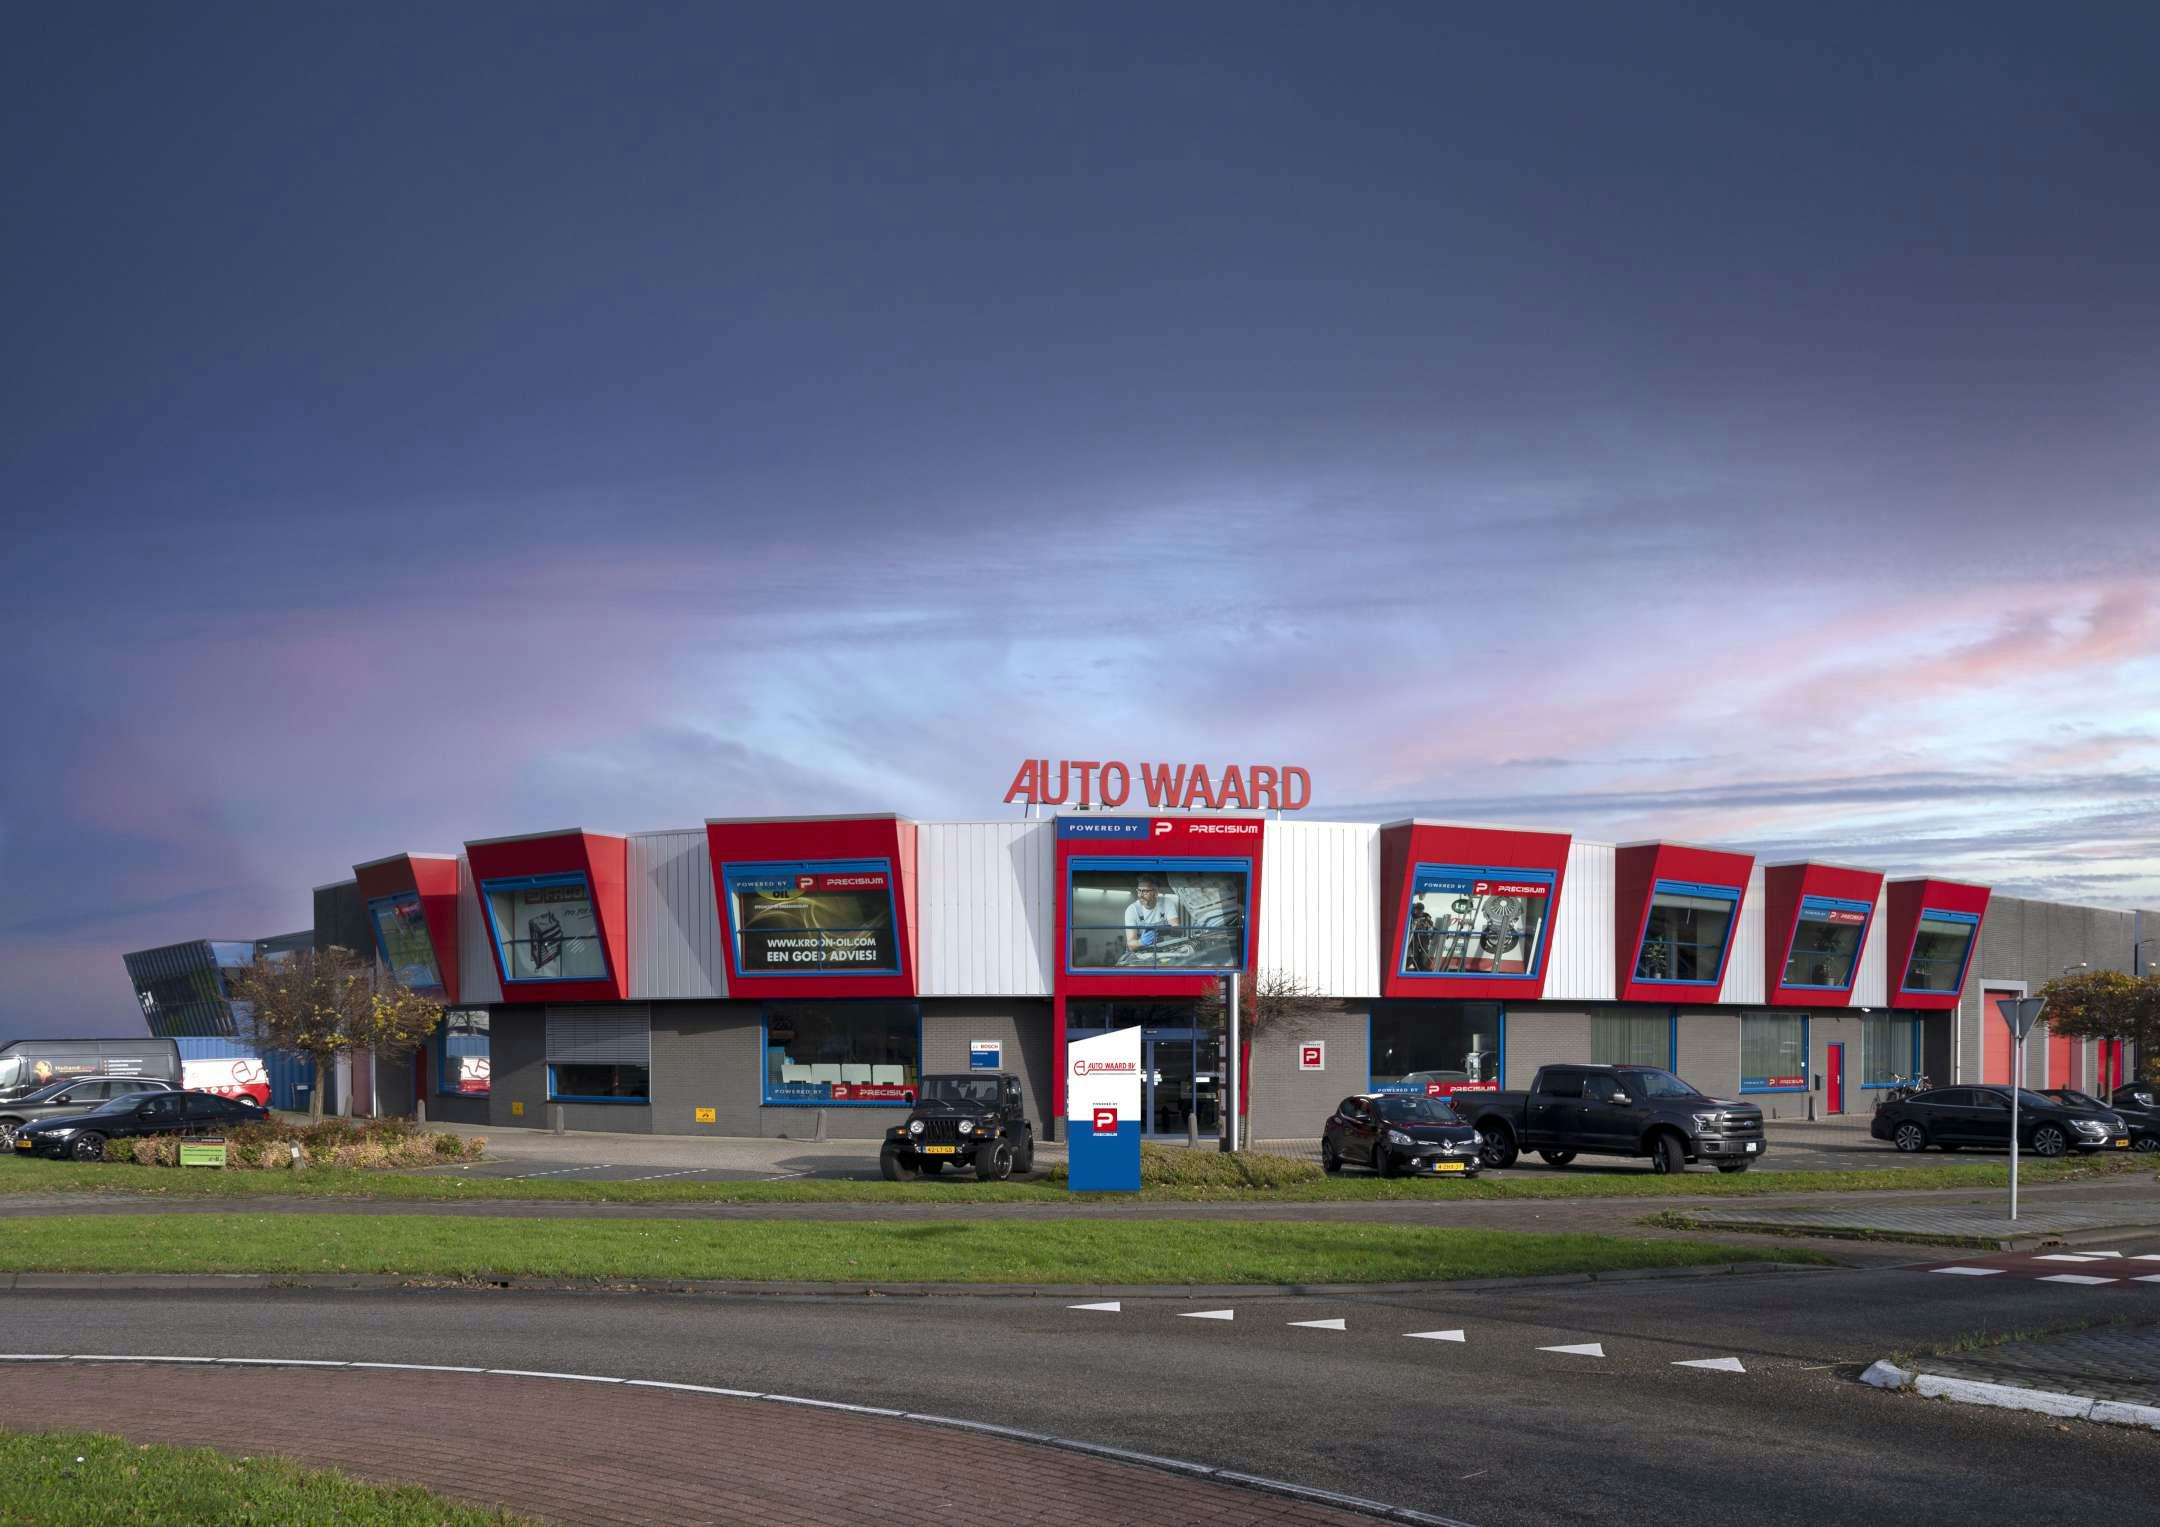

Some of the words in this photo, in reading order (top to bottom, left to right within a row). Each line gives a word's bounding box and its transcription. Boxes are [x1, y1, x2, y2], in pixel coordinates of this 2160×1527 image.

[1003, 759, 1131, 806] AUTO
[1140, 763, 1312, 810] WAARD
[1069, 824, 1121, 832] POWERED
[1125, 824, 1138, 832] BY
[1188, 825, 1259, 834] PRECISIUM
[826, 878, 884, 886] PRECISIUM
[773, 890, 790, 898] OIL
[1498, 885, 1546, 894] PRECISIUM
[767, 938, 876, 948] WWW.KROON-OIL.COM
[767, 951, 791, 962] EEN
[792, 951, 827, 962] GOED
[830, 950, 877, 961] ADVIES!
